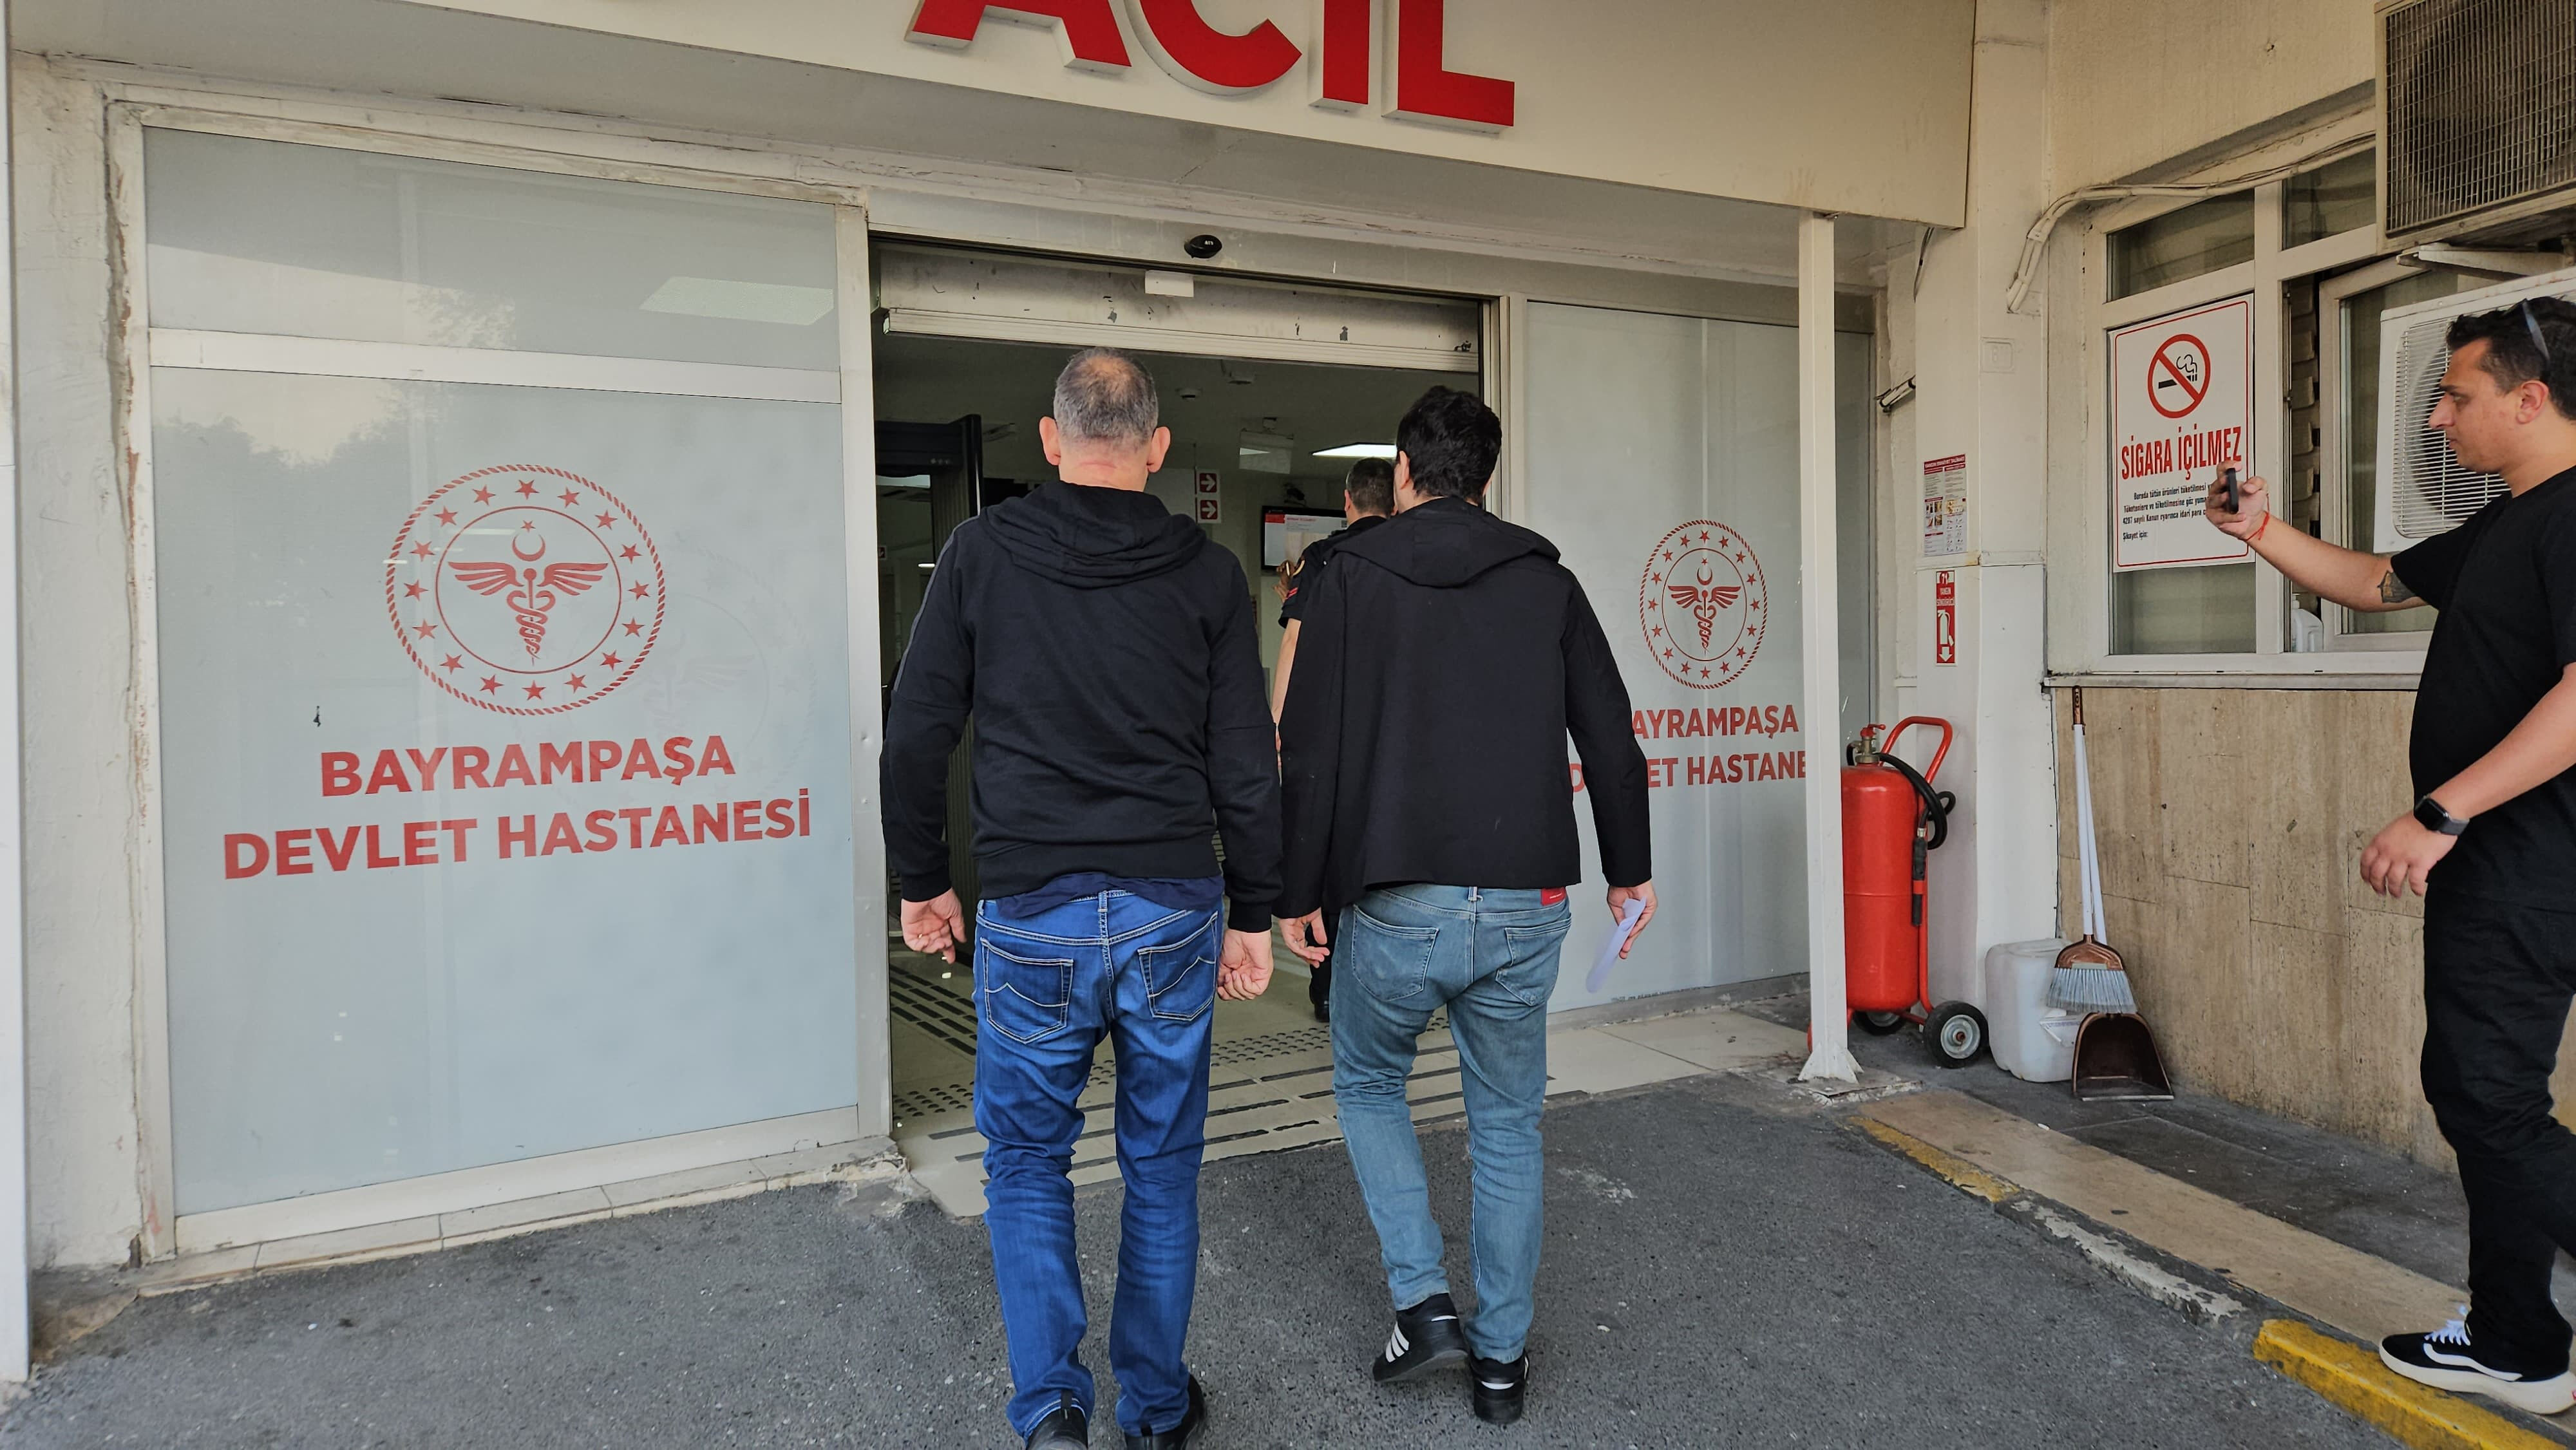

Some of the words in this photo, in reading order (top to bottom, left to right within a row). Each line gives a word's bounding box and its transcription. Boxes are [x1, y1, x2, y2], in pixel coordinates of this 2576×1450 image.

[2121, 435, 2173, 480] SİGARA
[2178, 423, 2242, 480] İÇİLMEZ
[2192, 509, 2201, 518] para
[1632, 704, 1799, 739] AYRAMPAŞA
[321, 735, 736, 797] BAYRAMPAŞA
[1687, 751, 1806, 786] HASTANE
[224, 818, 478, 880] DEVLET
[498, 787, 810, 860] HASTANESİ
